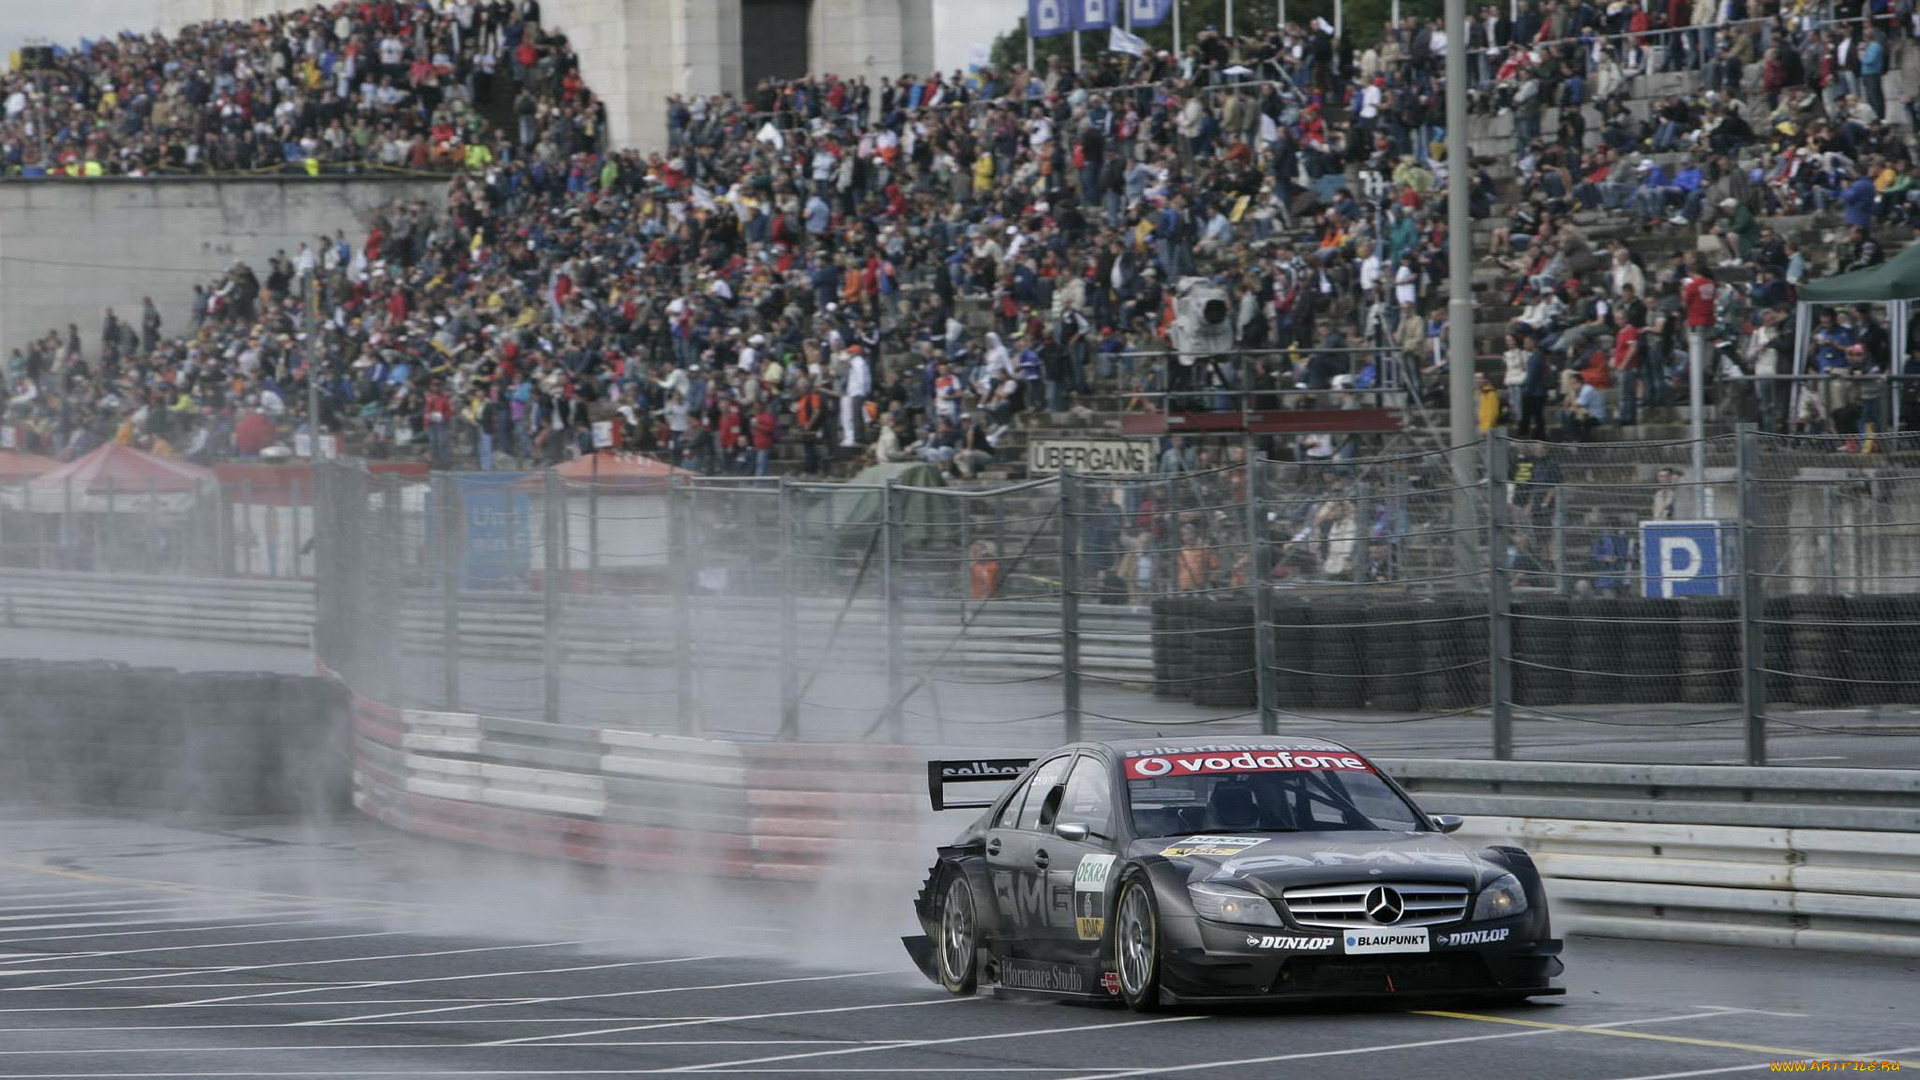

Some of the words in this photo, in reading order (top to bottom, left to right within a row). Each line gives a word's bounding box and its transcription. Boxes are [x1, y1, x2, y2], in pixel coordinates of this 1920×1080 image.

[1035, 441, 1145, 471] ÜBERGANG
[1660, 537, 1702, 598] P
[1125, 743, 1346, 758] selberfahren.com
[1177, 752, 1367, 771] vodafone
[1077, 862, 1109, 882] DEKRA
[994, 871, 1073, 928] AMG
[1084, 893, 1092, 918] 6
[1083, 919, 1101, 938] ADAC
[1448, 928, 1509, 947] DUNLOP
[1258, 936, 1335, 950] DUNLOP
[1357, 935, 1426, 947] BLAUPUNKT
[1052, 966, 1082, 991] Studio
